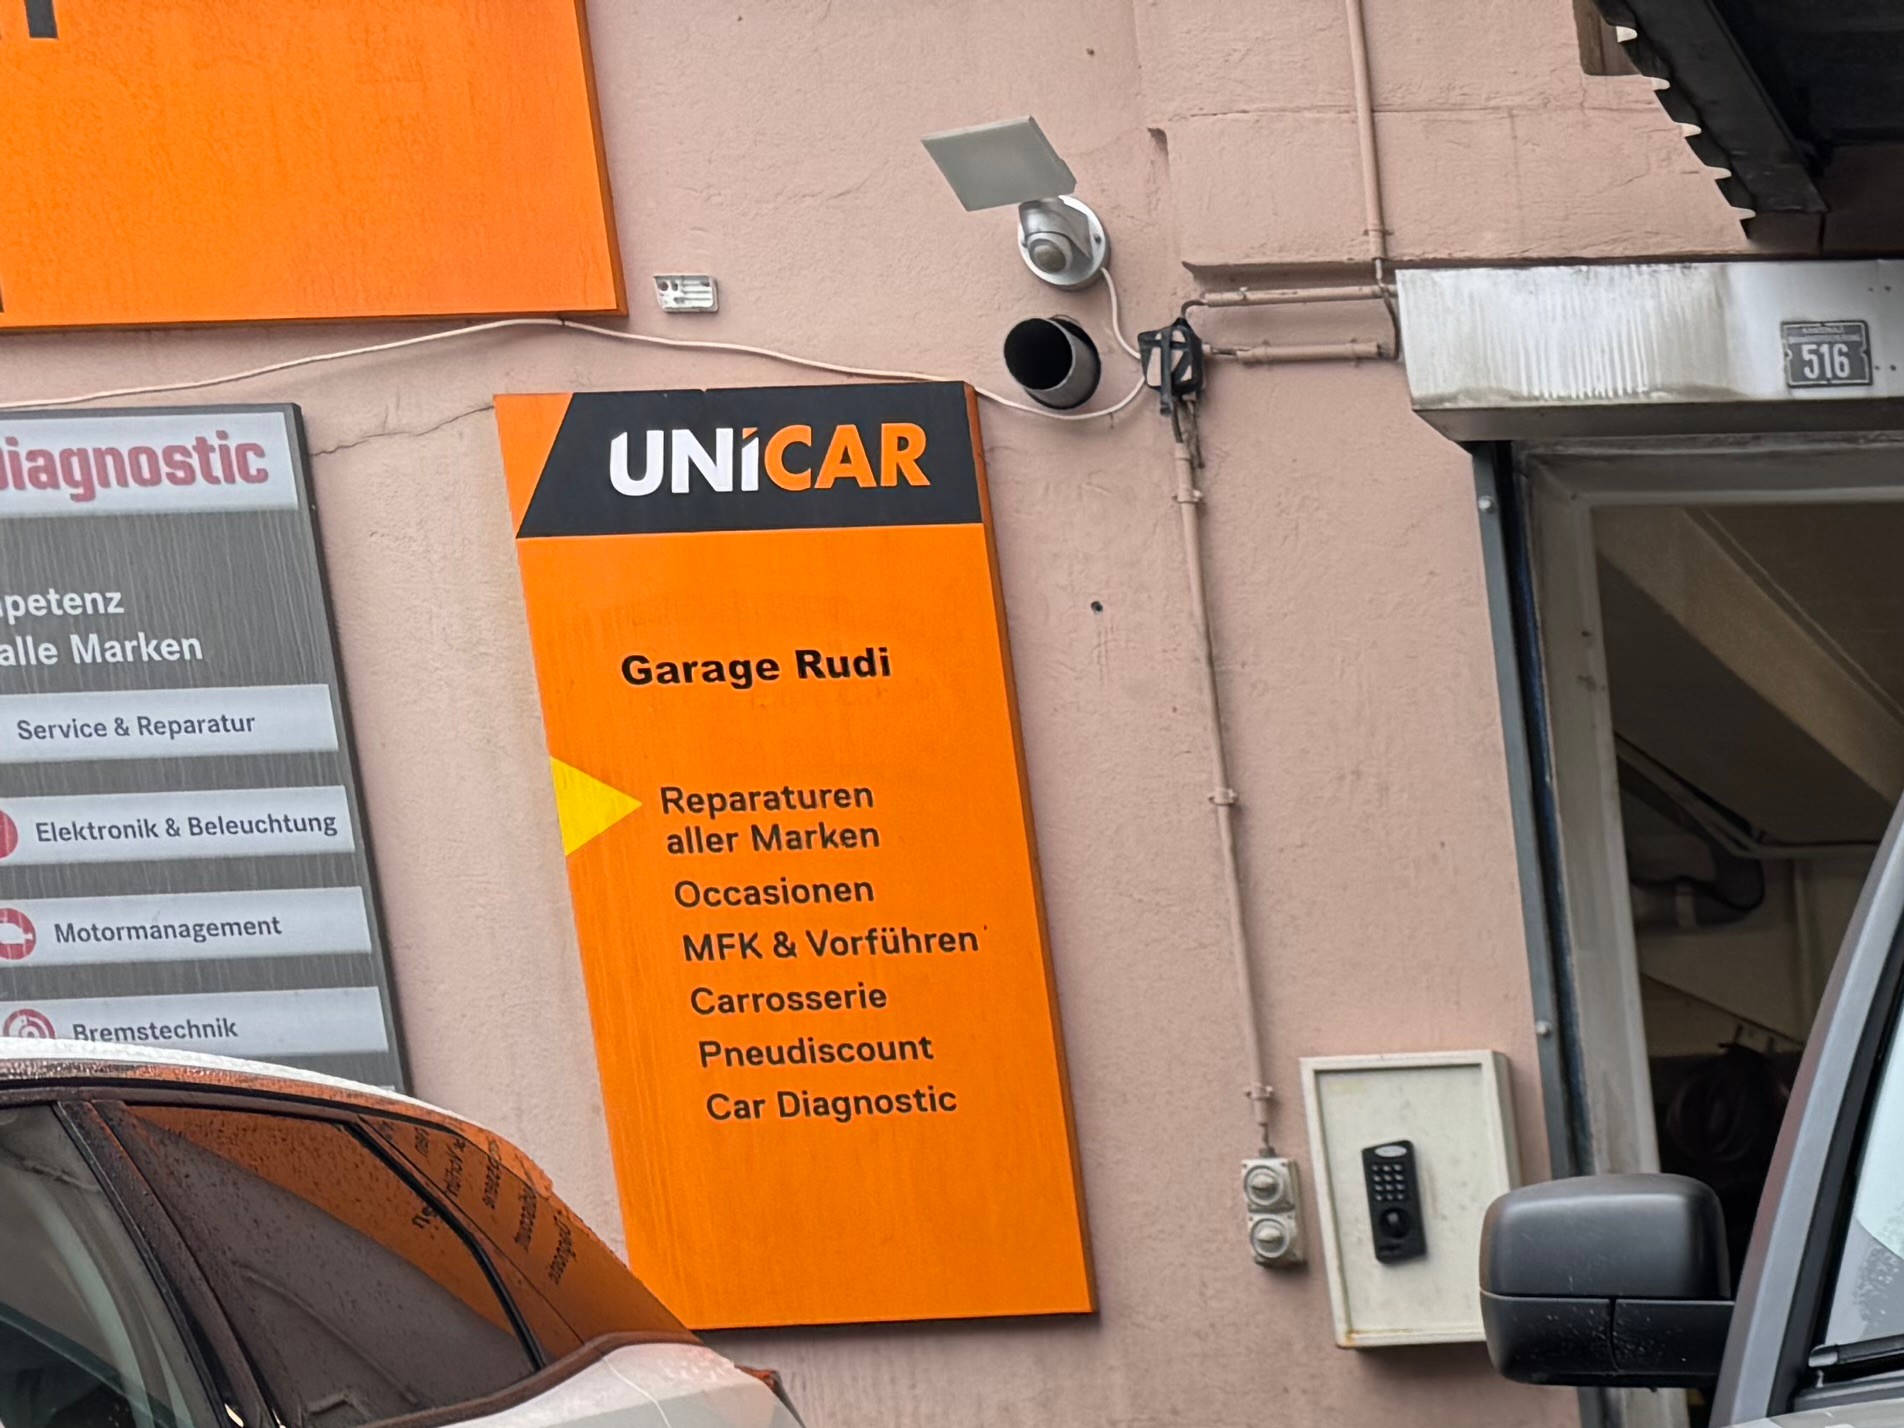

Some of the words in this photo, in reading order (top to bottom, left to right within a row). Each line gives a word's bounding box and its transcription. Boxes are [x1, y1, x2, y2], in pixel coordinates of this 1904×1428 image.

[1802, 343, 1850, 379] 516
[0, 429, 269, 503] iagnostic
[0, 588, 125, 625] petenz
[69, 632, 203, 664] Marken
[620, 653, 781, 690] Garage
[795, 647, 892, 681] Rudi
[17, 718, 108, 741] Service
[115, 716, 130, 737] &
[136, 713, 257, 740] Reparatur
[660, 785, 875, 819] Reparaturen
[36, 818, 159, 842] Elektronik
[165, 816, 182, 837] &
[188, 812, 338, 840] Beleuchtung
[666, 826, 738, 855] aller
[752, 822, 880, 852] Marken
[674, 876, 875, 908] Occasionen
[54, 916, 283, 947] Motormanagement
[682, 932, 762, 962] MFK
[773, 931, 798, 957] &
[805, 926, 980, 956] Vorführen
[690, 981, 888, 1015] Carrosserie
[72, 1017, 238, 1043] Bremstechnik
[699, 1036, 934, 1069] Pneudiscount
[706, 1092, 766, 1121] Car
[778, 1084, 957, 1122] Diagnostic
